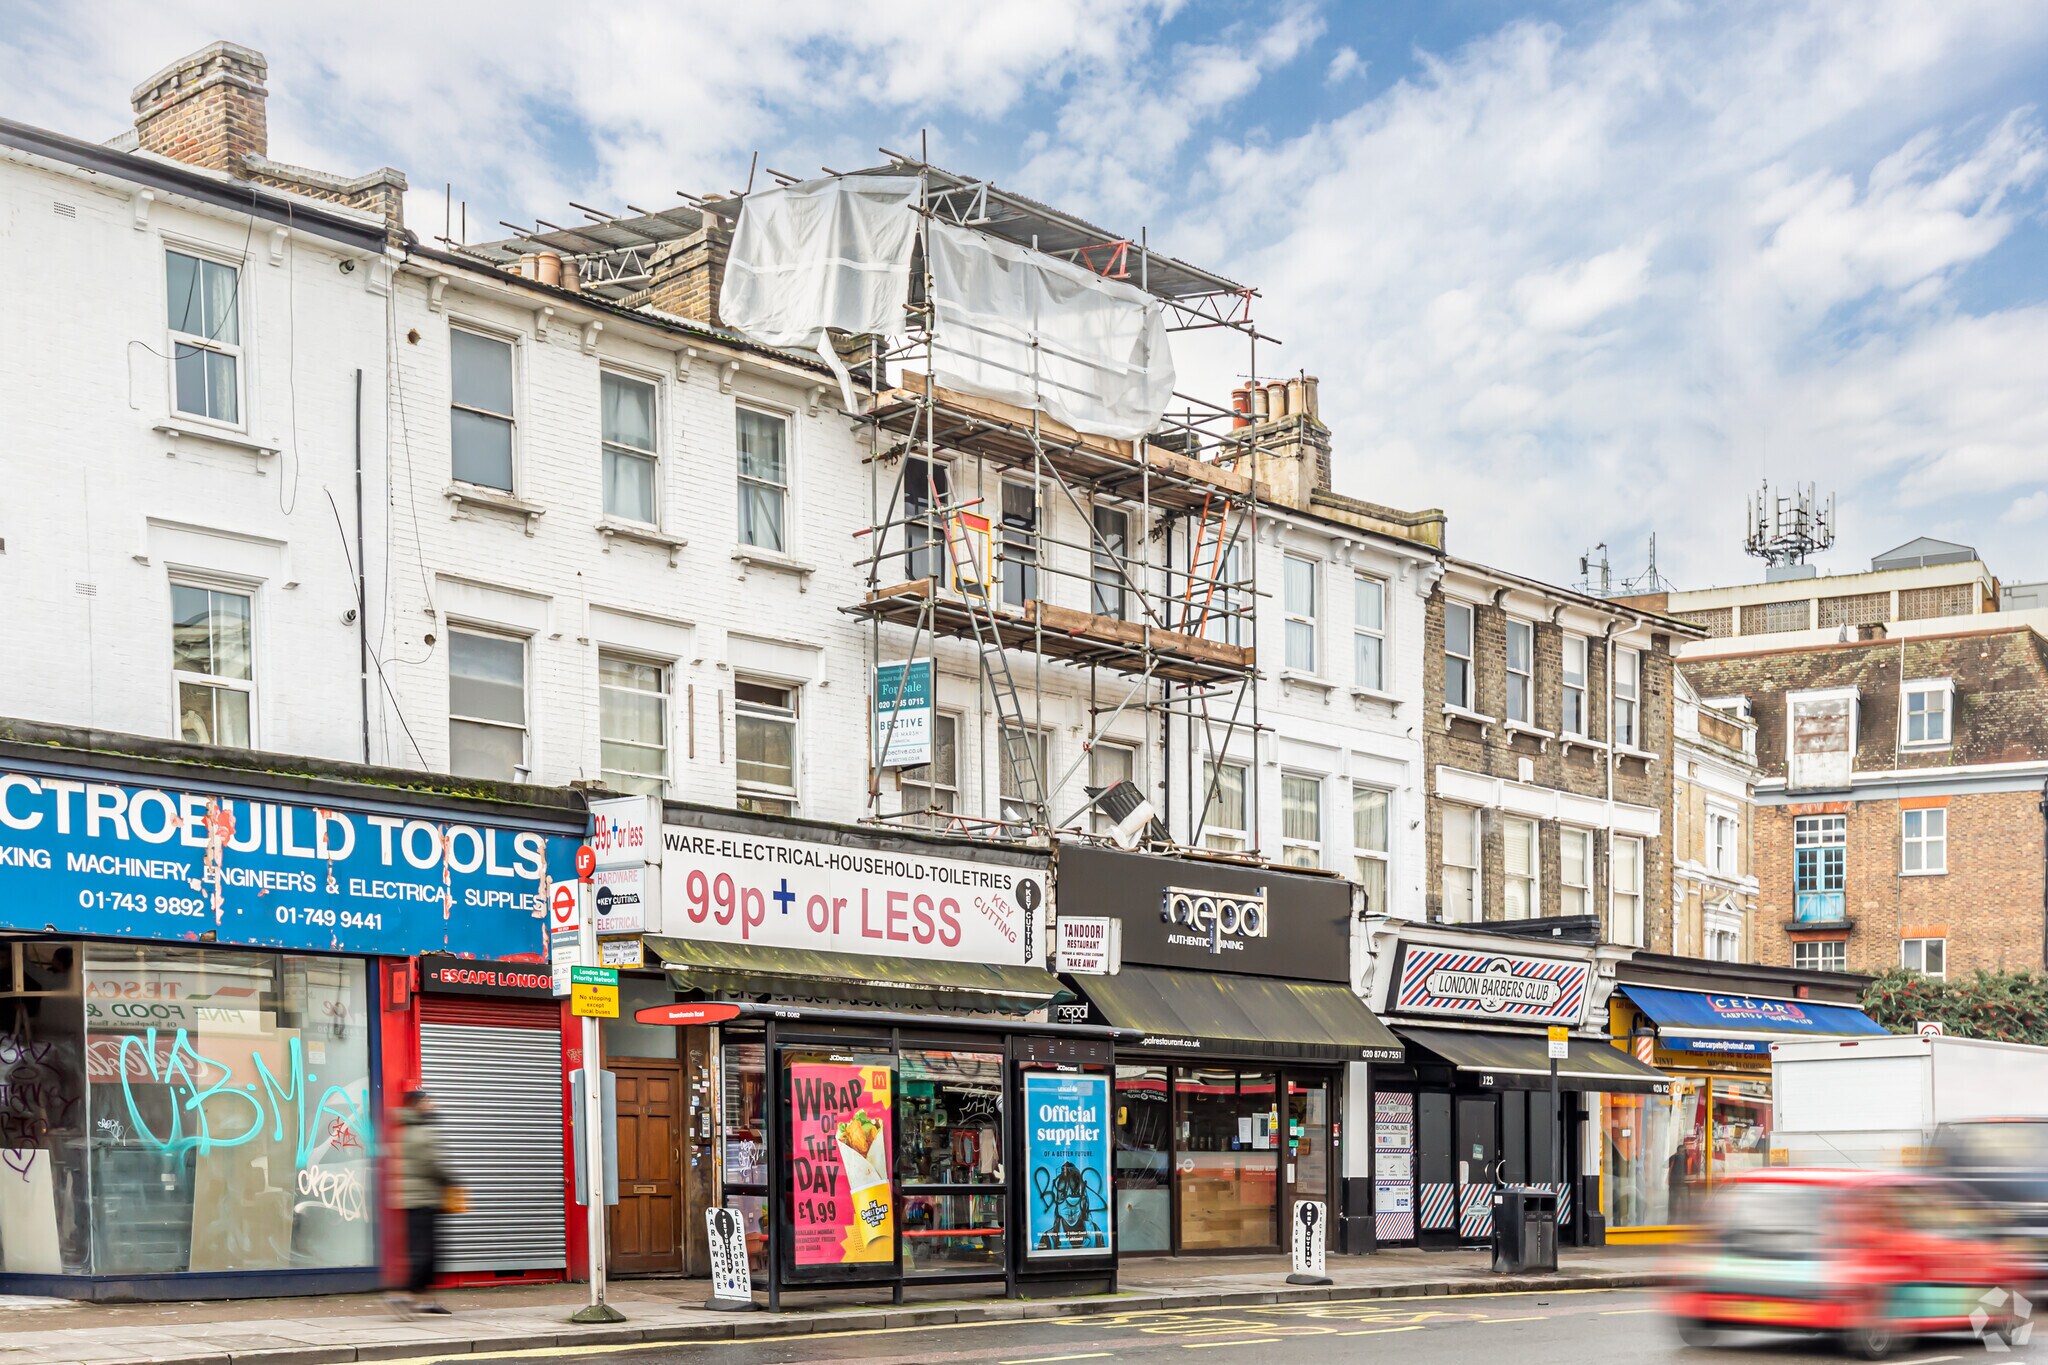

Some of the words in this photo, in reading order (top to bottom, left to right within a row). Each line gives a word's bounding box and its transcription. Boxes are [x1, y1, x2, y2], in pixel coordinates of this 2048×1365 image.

[882, 684, 899, 695] For
[879, 701, 891, 709] 020
[908, 697, 925, 706] 0715
[880, 718, 923, 731] BECTIVE
[628, 821, 644, 847] less
[367, 815, 546, 880] TOOLS
[578, 854, 590, 869] LF
[67, 852, 191, 882] MACHINERY,
[326, 877, 339, 895] &
[350, 878, 457, 904] ELECTRICAL
[464, 888, 545, 911] SUPPLIES
[597, 870, 638, 885] HARDWARE
[79, 889, 147, 912] 01-743
[154, 896, 205, 917] 9892
[601, 897, 612, 905] KEY
[613, 894, 638, 904] CUTTING
[992, 893, 1014, 918] KEY
[276, 905, 336, 926] 01-749
[340, 911, 382, 930] 9441
[597, 916, 641, 930] ELECTRICAL
[807, 894, 847, 935] or
[862, 887, 961, 947] LESS
[974, 896, 1017, 943] CUTTING
[1164, 886, 1268, 954] nepal
[1064, 924, 1104, 938] TANDOORI
[1067, 940, 1099, 950] RESTAURANT
[1168, 934, 1210, 948] AUTHENTIC
[1067, 958, 1082, 967] TAKE
[1083, 959, 1098, 968] AWAY
[440, 968, 496, 985] ESCAPE
[1439, 975, 1480, 995] LONDON
[1481, 979, 1524, 999] BARBERS
[1525, 983, 1550, 1001] CLUB
[589, 995, 612, 1003] stopping
[1716, 999, 1788, 1014] CEDAR
[1721, 1011, 1756, 1020] CARPETS
[1363, 1050, 1373, 1058] 020
[1374, 1050, 1388, 1059] 8740
[1389, 1051, 1402, 1059] 7551
[1693, 1040, 1755, 1051] cedarcarpets@hotmail.com
[794, 1078, 862, 1121] WRAP
[821, 1112, 838, 1133] OF
[1040, 1105, 1096, 1123] Official
[1037, 1125, 1100, 1146] supplier
[804, 1135, 838, 1162] THE
[794, 1157, 839, 1197] DAY
[798, 1199, 836, 1224] £1.99
[708, 1209, 721, 1289] HARDWARE
[735, 1210, 748, 1292] ELECTRICAL
